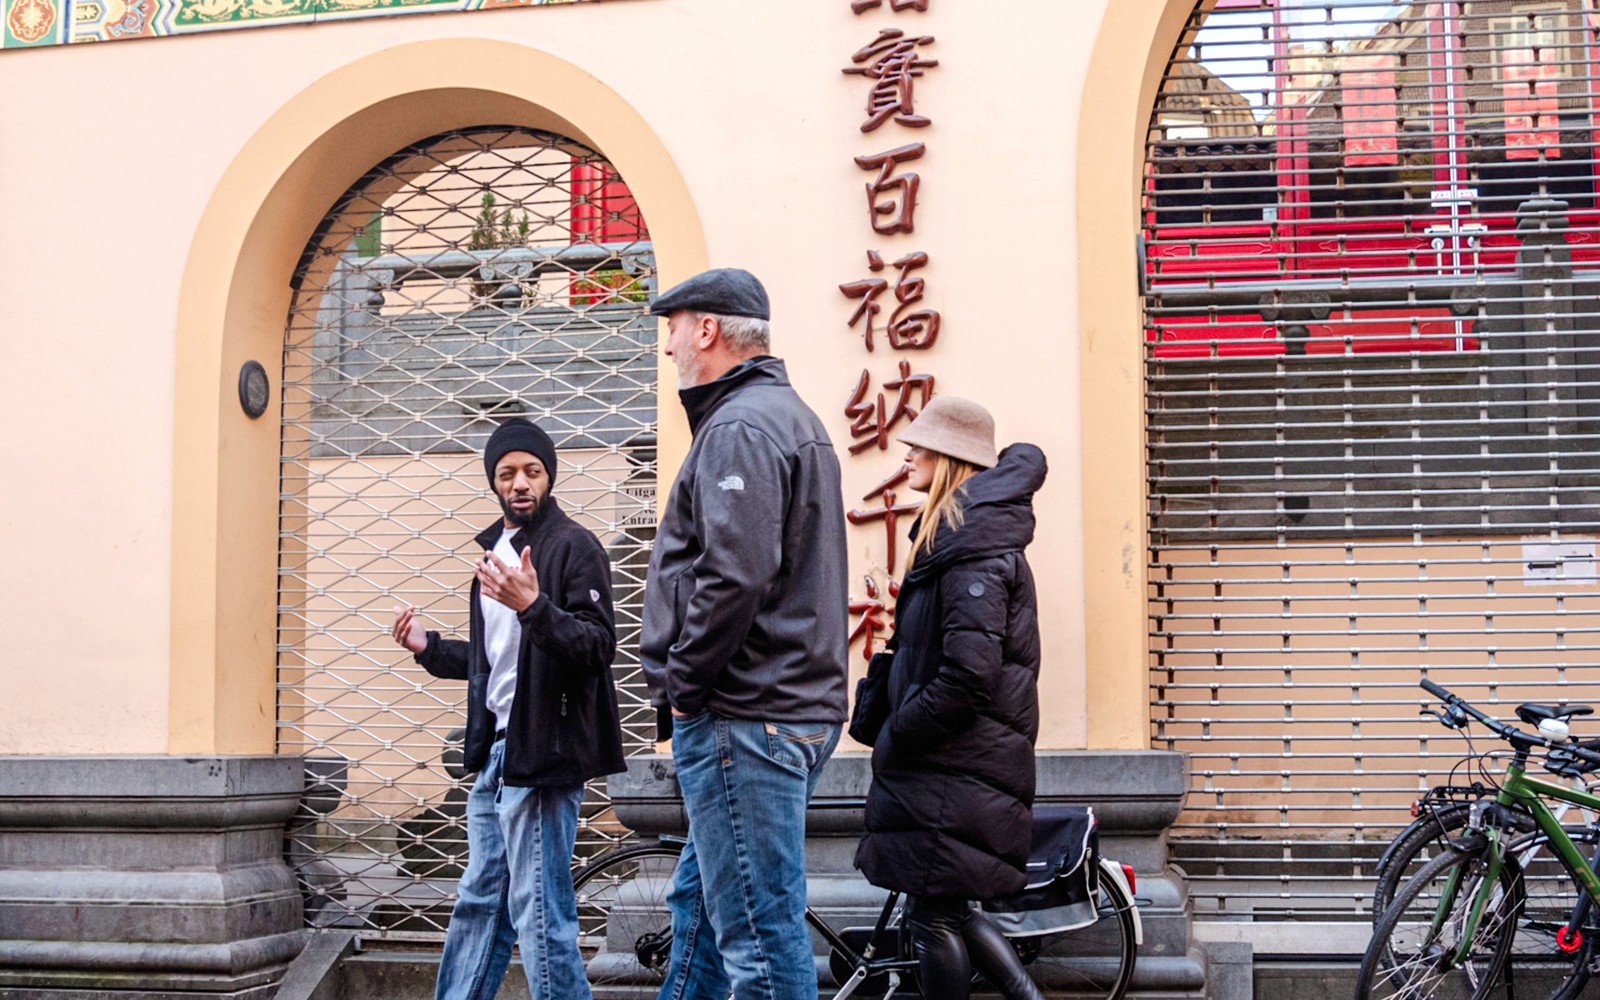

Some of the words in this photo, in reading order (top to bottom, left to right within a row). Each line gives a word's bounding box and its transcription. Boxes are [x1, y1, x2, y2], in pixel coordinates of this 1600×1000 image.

[840, 0, 940, 660] 實百福納千
